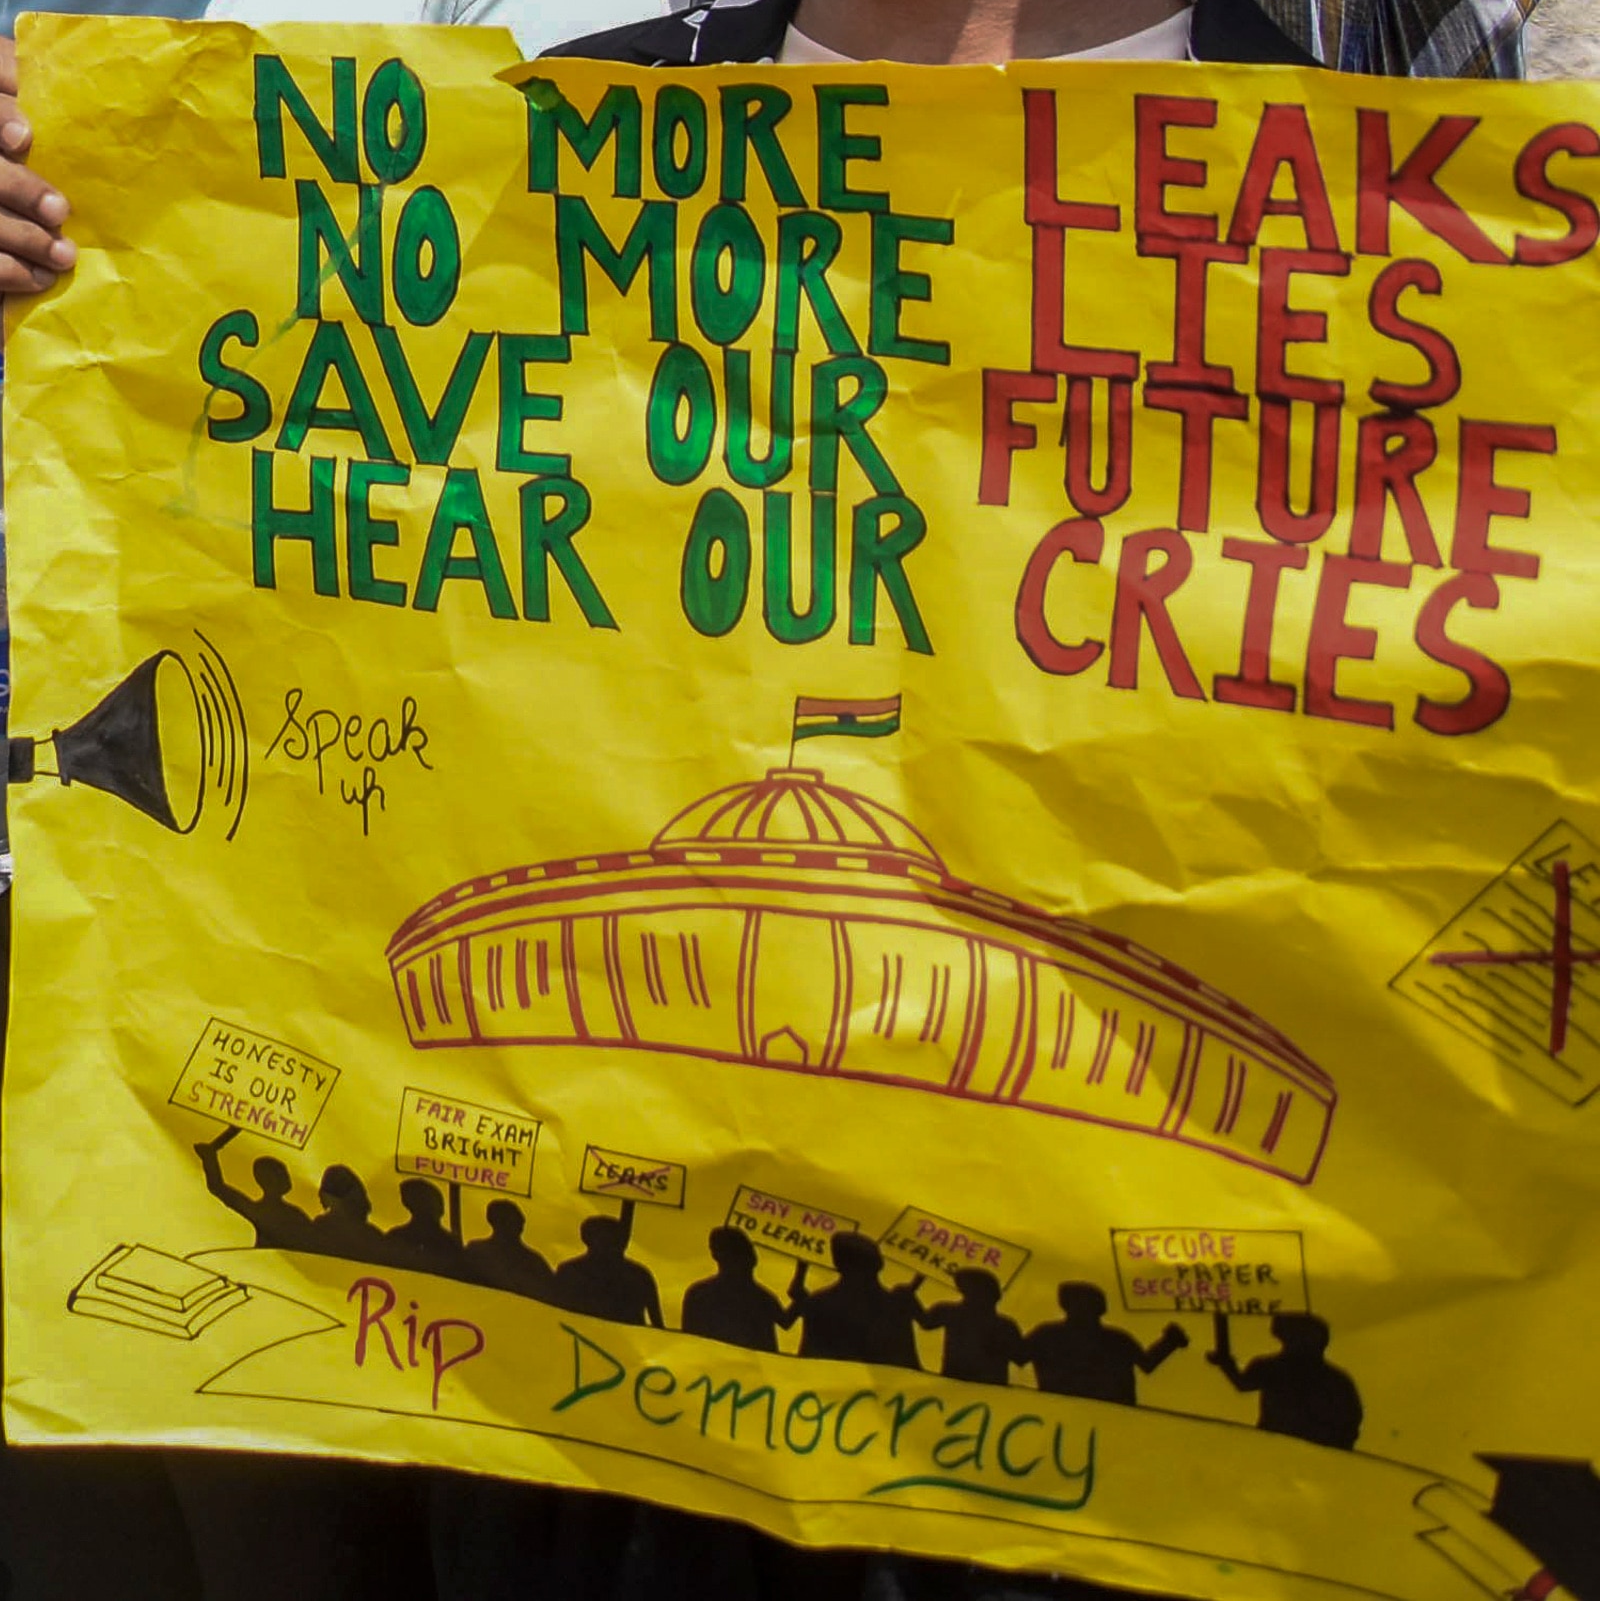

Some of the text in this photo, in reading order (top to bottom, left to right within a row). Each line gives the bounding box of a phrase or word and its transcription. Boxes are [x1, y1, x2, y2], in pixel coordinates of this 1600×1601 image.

[253, 53, 1600, 269] NO MORE LEAKS
[295, 178, 1462, 409] NO MORE LIES
[200, 309, 1558, 581] SAVE OUR FUTURE
[251, 448, 1511, 737] HEAR OUR CRIES
[263, 687, 434, 795] Speak
[208, 1057, 297, 1115] IS OUR
[212, 1029, 327, 1093] HONESTY
[188, 1079, 310, 1145] STRENGTH
[415, 1097, 534, 1148] FAIR EXAM
[414, 1156, 511, 1190] FUTURE
[423, 1126, 523, 1168] BRIGHT
[593, 1160, 670, 1192] LEAKS
[732, 1209, 827, 1256] TO LEAKS
[746, 1192, 838, 1234] SAY NO
[915, 1217, 1004, 1269] PAPER
[1126, 1231, 1237, 1261] SECURE
[1132, 1277, 1233, 1302] SECURE
[1174, 1261, 1279, 1286] PAPER
[346, 1276, 1099, 1512] Rip Democracy
